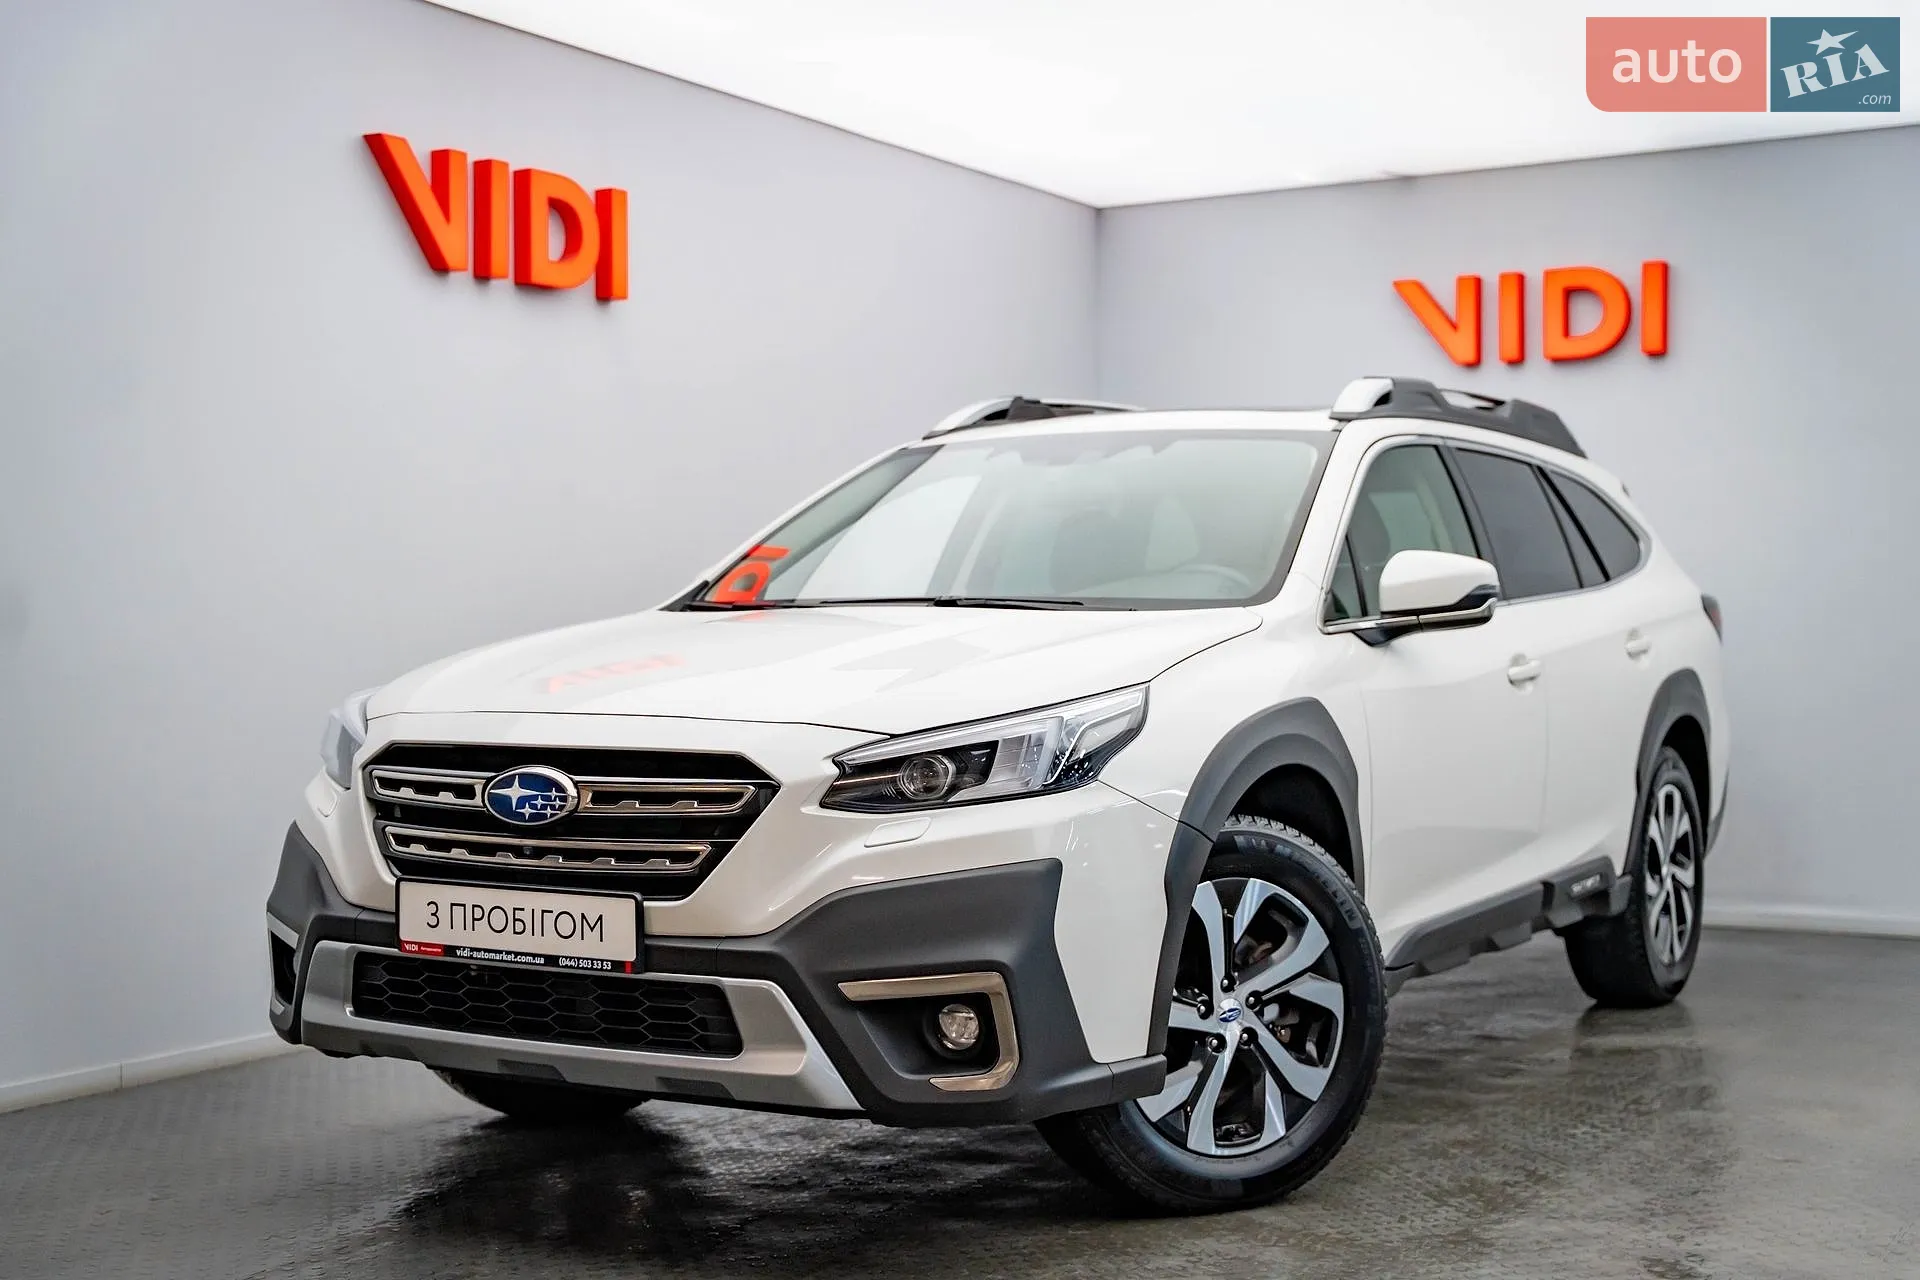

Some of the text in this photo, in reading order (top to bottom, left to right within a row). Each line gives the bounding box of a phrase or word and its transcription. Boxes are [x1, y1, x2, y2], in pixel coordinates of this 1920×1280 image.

[362, 132, 628, 301] VIDI
[1393, 259, 1669, 367] VIDI
[449, 902, 604, 943] ПРОБІГОМ
[404, 943, 419, 952] VIDI
[456, 947, 545, 965] vidi-automarket.com.ua
[558, 956, 612, 970] (044) 503 33 53
